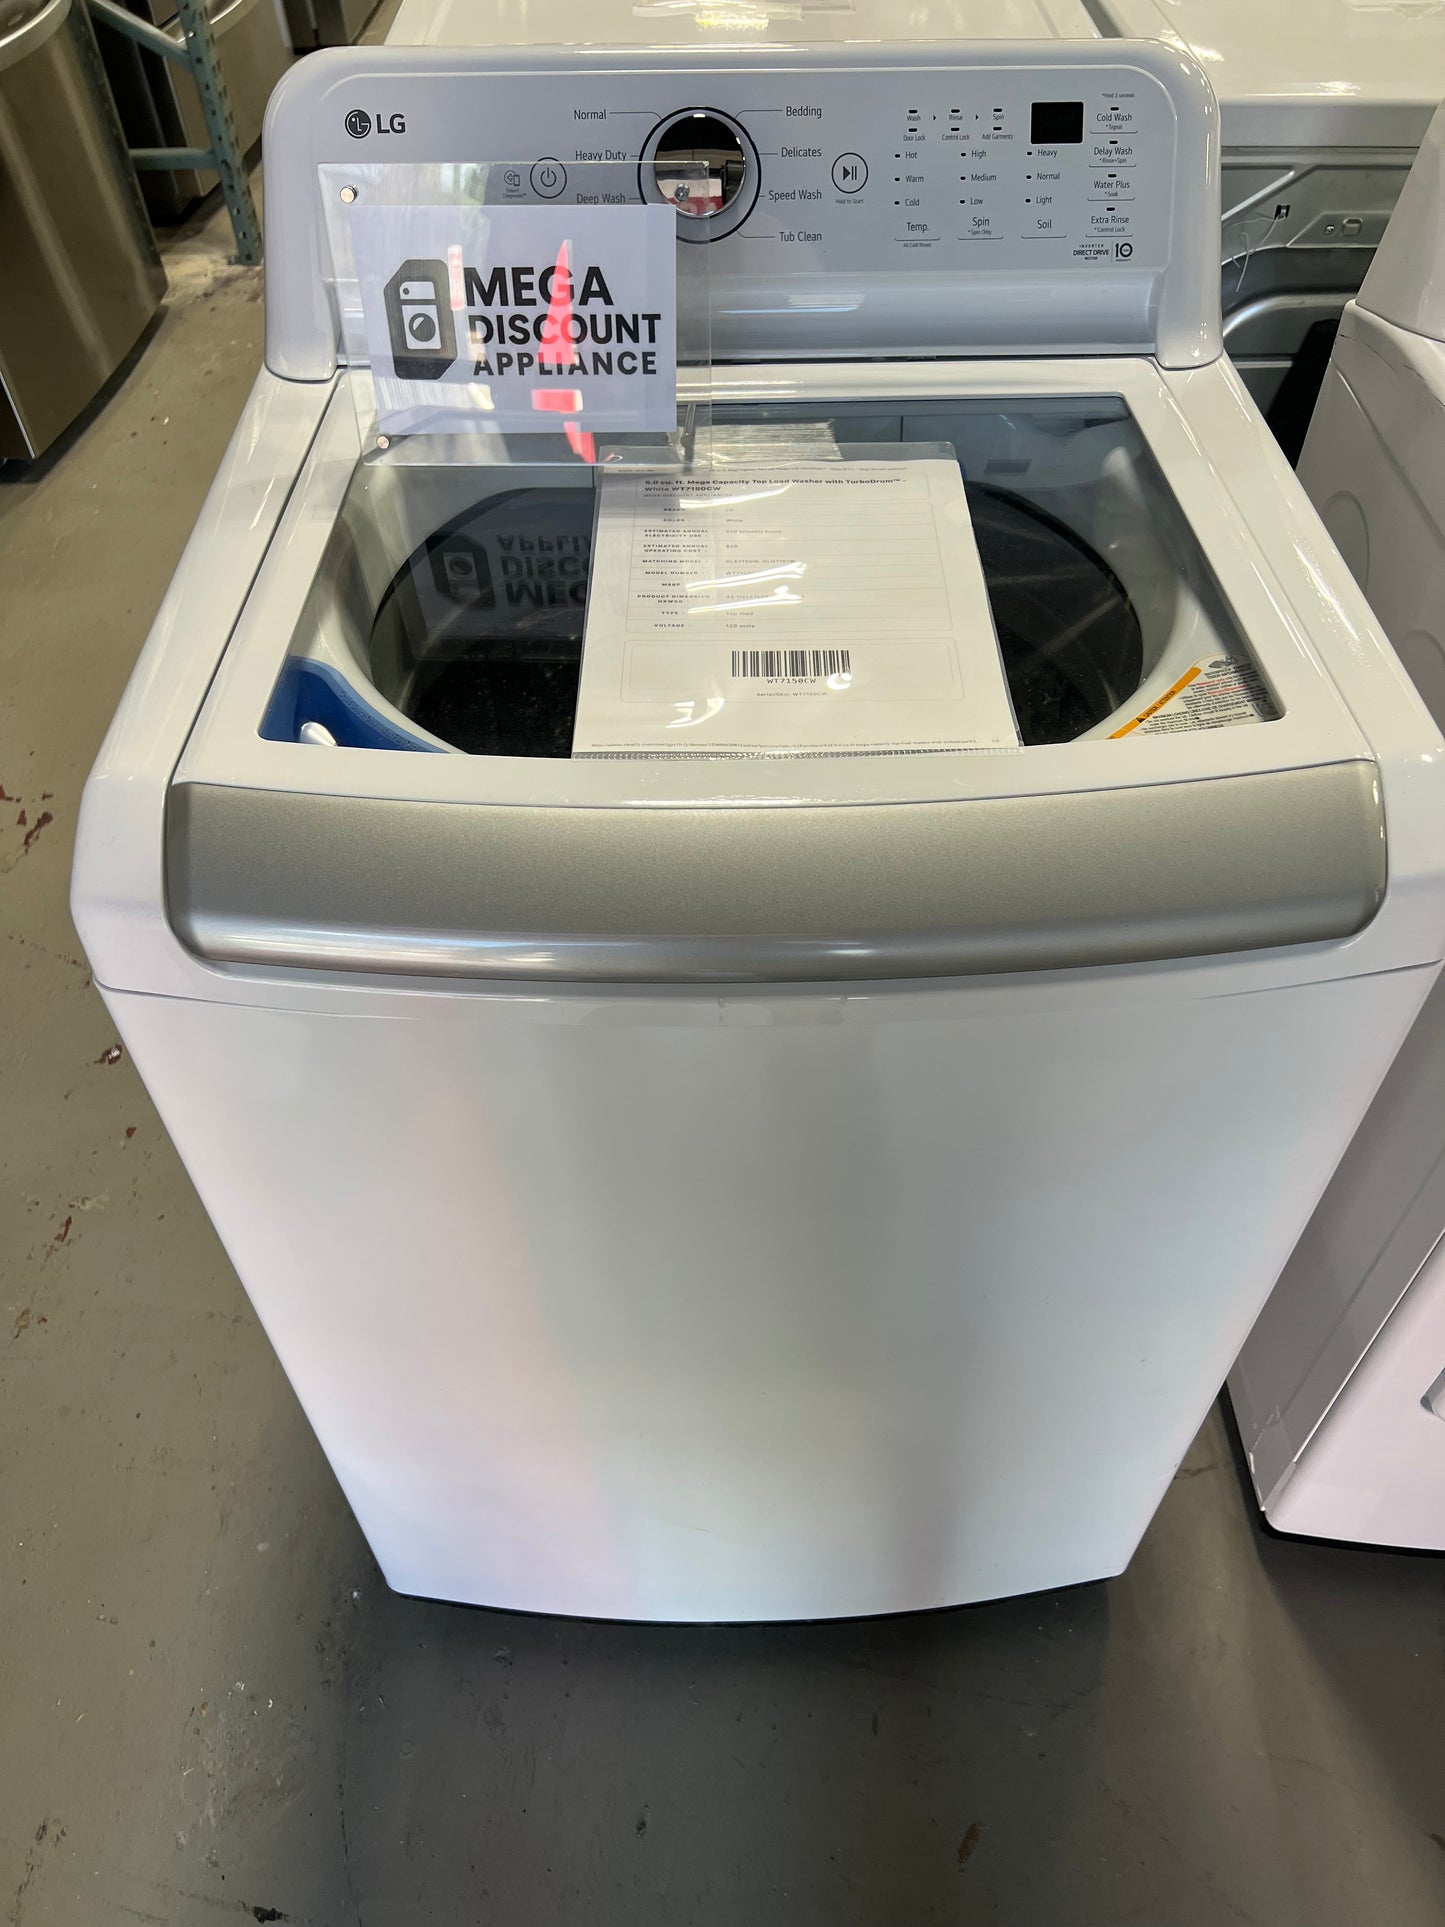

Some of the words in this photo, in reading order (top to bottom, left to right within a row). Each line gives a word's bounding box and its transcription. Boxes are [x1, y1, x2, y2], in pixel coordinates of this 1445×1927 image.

[573, 109, 607, 120] Normal
[785, 106, 822, 119] Bedding
[1096, 113, 1112, 122] Cold
[1113, 113, 1133, 122] Wash
[376, 113, 406, 134] LG
[575, 150, 603, 161] Heavy
[605, 150, 627, 161] Duty
[781, 147, 822, 158] Delicates
[971, 150, 987, 160] High
[1037, 149, 1058, 158] Heavy
[1093, 147, 1112, 157] Delay
[1114, 146, 1133, 155] Wash
[905, 175, 925, 183] Warm
[1036, 172, 1061, 180] Normal
[1093, 181, 1114, 189] Water
[1115, 180, 1130, 188] Plus
[576, 194, 600, 205] Deep
[602, 193, 626, 203] Wash
[768, 190, 796, 203] Speed
[798, 189, 822, 200] Wash
[970, 197, 984, 205] Low
[1035, 196, 1052, 206] Light
[972, 217, 990, 228] Spin
[1037, 219, 1052, 229] Soil
[1091, 216, 1109, 224] Extra
[1110, 215, 1130, 224] Rinse
[906, 222, 930, 233] Temp.
[779, 231, 795, 242] Tub
[797, 231, 822, 242] Clean
[1115, 242, 1133, 258] 10
[463, 265, 615, 307] MEGA
[467, 313, 662, 345] DISCOUNT
[473, 351, 657, 376] APPLIANCE
